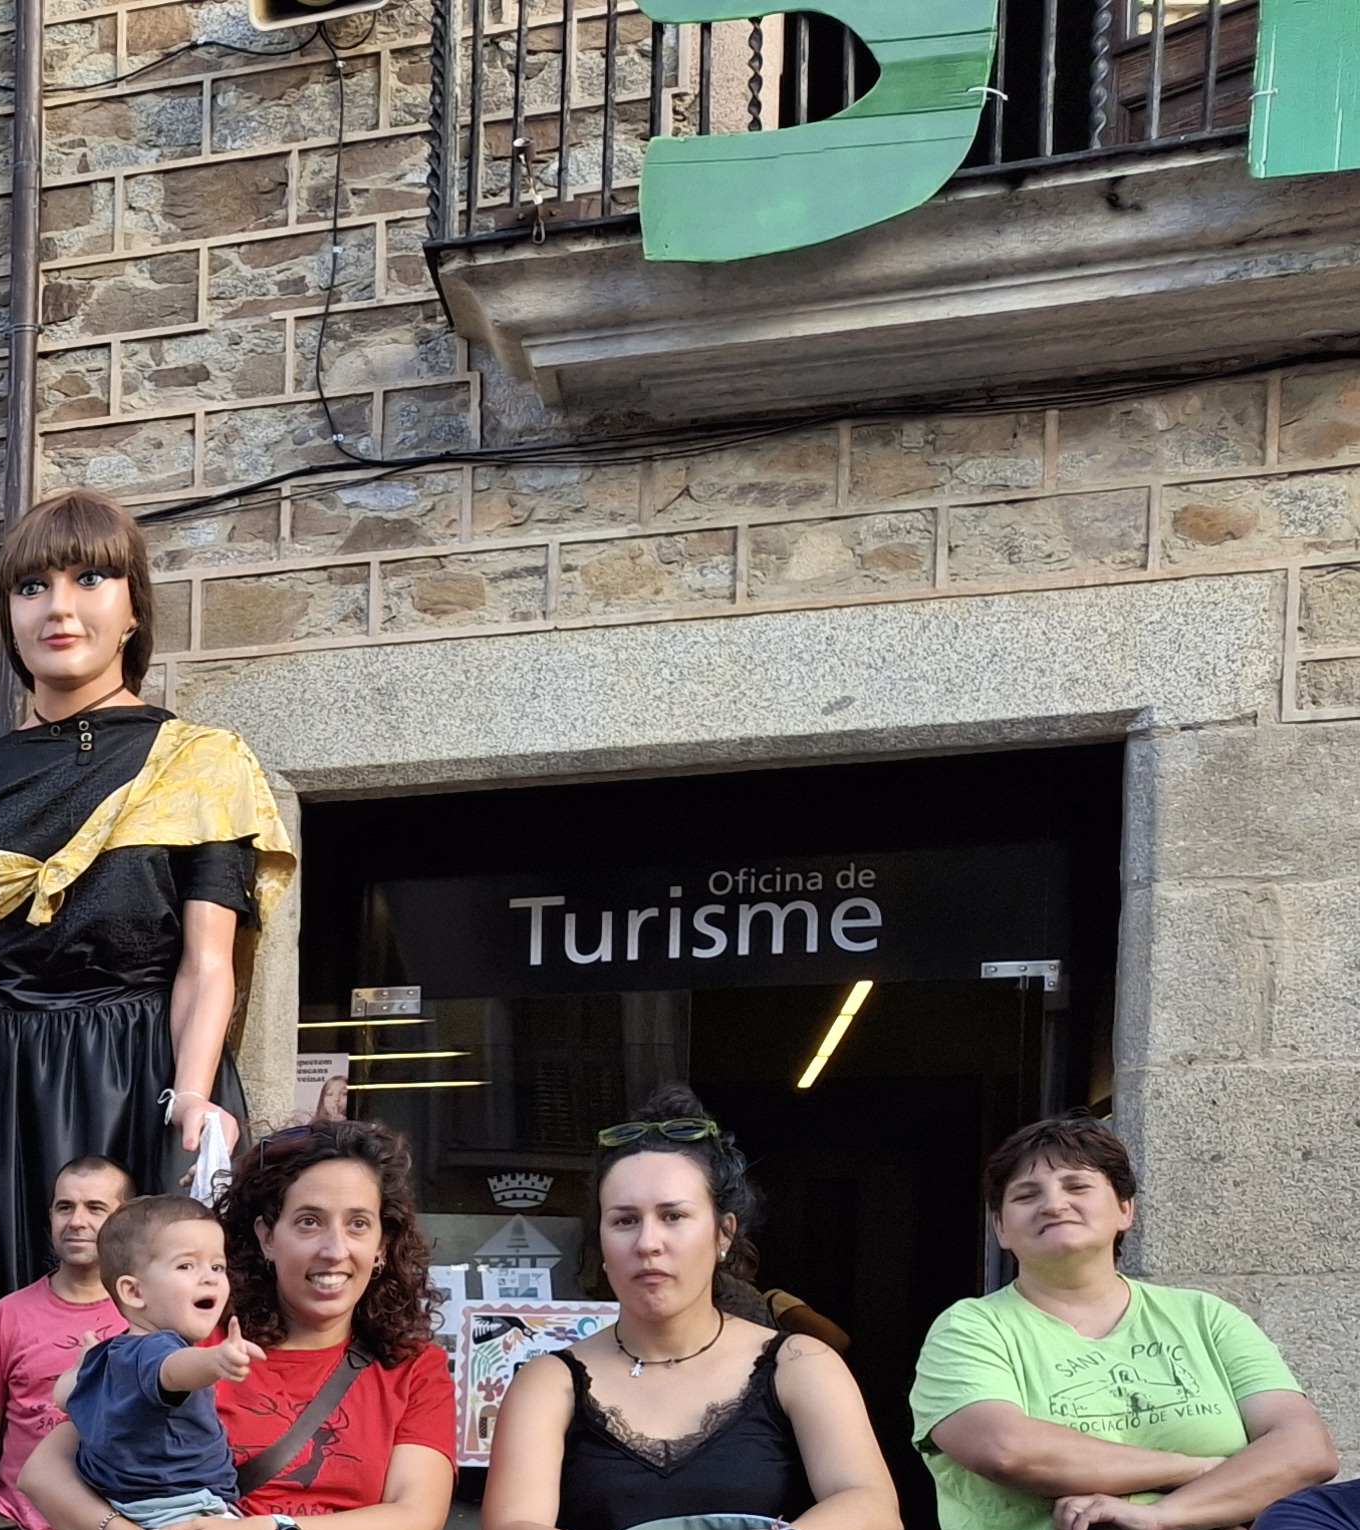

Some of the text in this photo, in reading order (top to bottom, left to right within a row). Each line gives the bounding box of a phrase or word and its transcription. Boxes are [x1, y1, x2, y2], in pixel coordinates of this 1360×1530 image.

[708, 862, 877, 896] Oficina de
[509, 886, 882, 966] Turisme
[1054, 1351, 1107, 1378] SANT
[1148, 1412, 1167, 1425] DE
